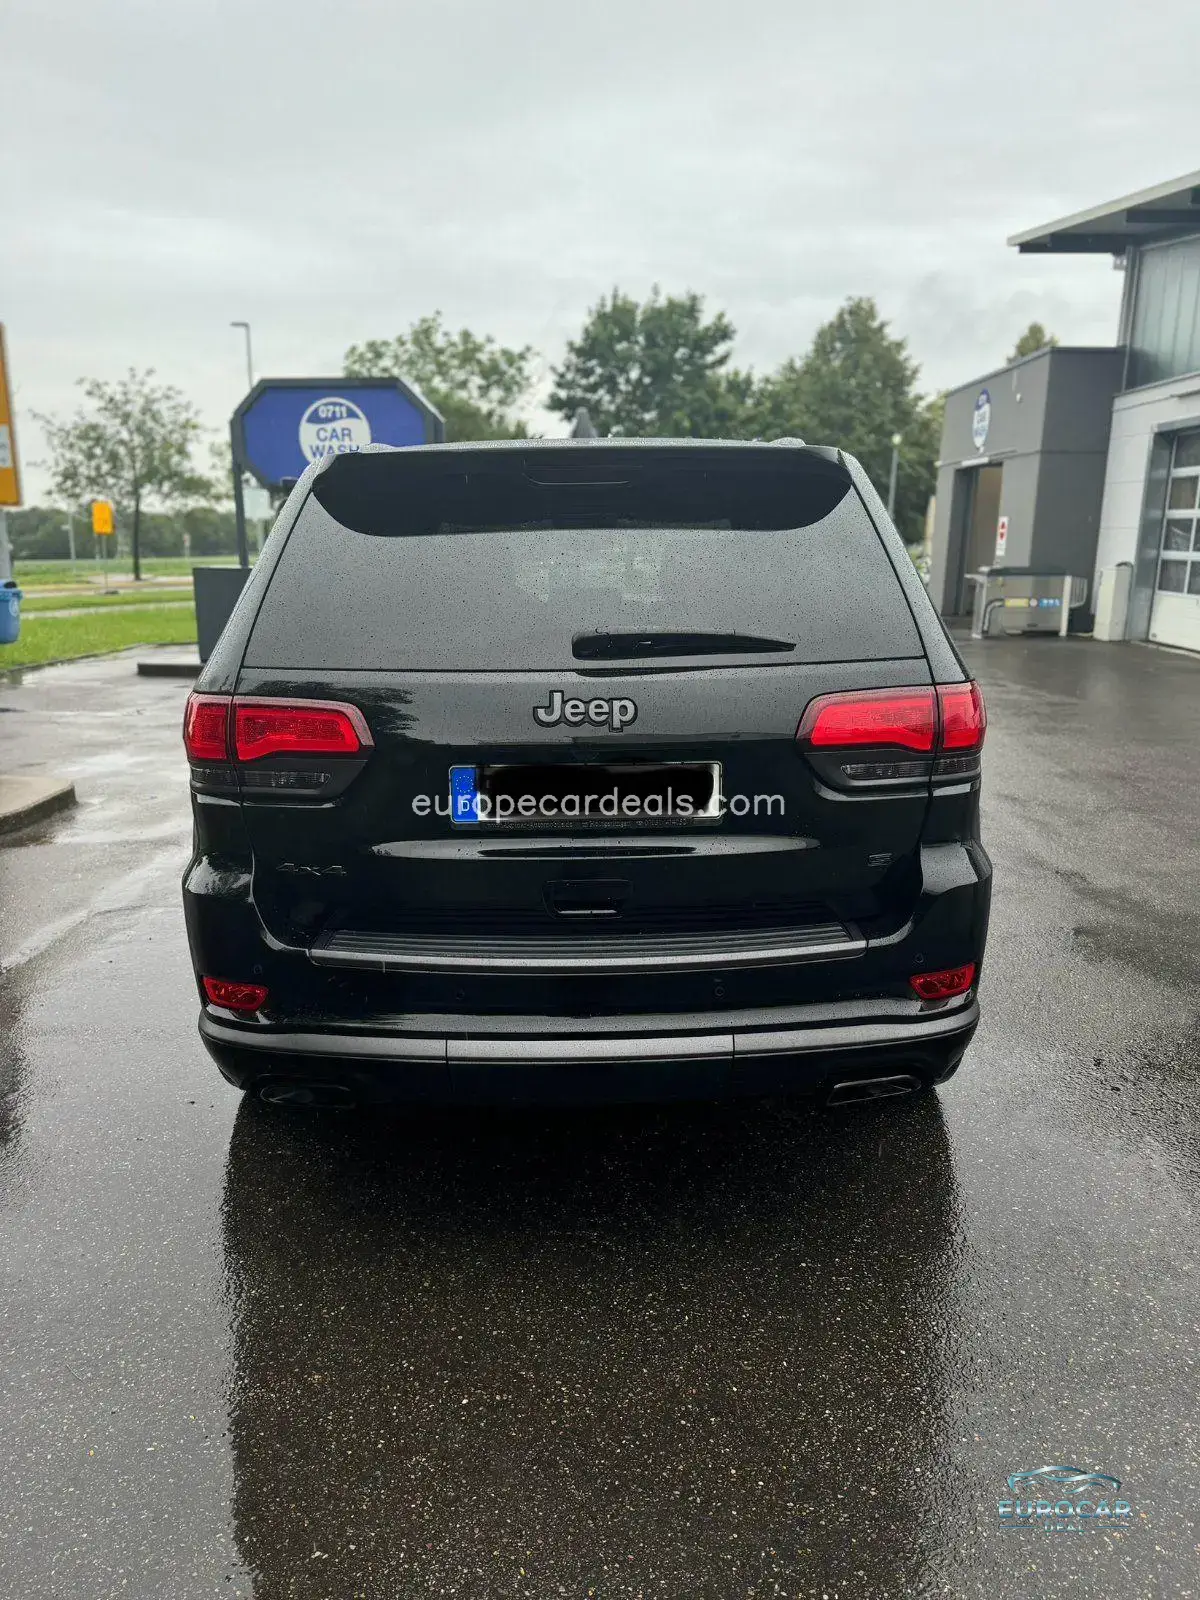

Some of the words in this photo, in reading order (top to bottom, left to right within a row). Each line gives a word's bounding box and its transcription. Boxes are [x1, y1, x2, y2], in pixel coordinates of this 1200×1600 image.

[318, 405, 347, 418] 0711
[316, 427, 352, 441] CAR
[534, 690, 638, 732] Jeep
